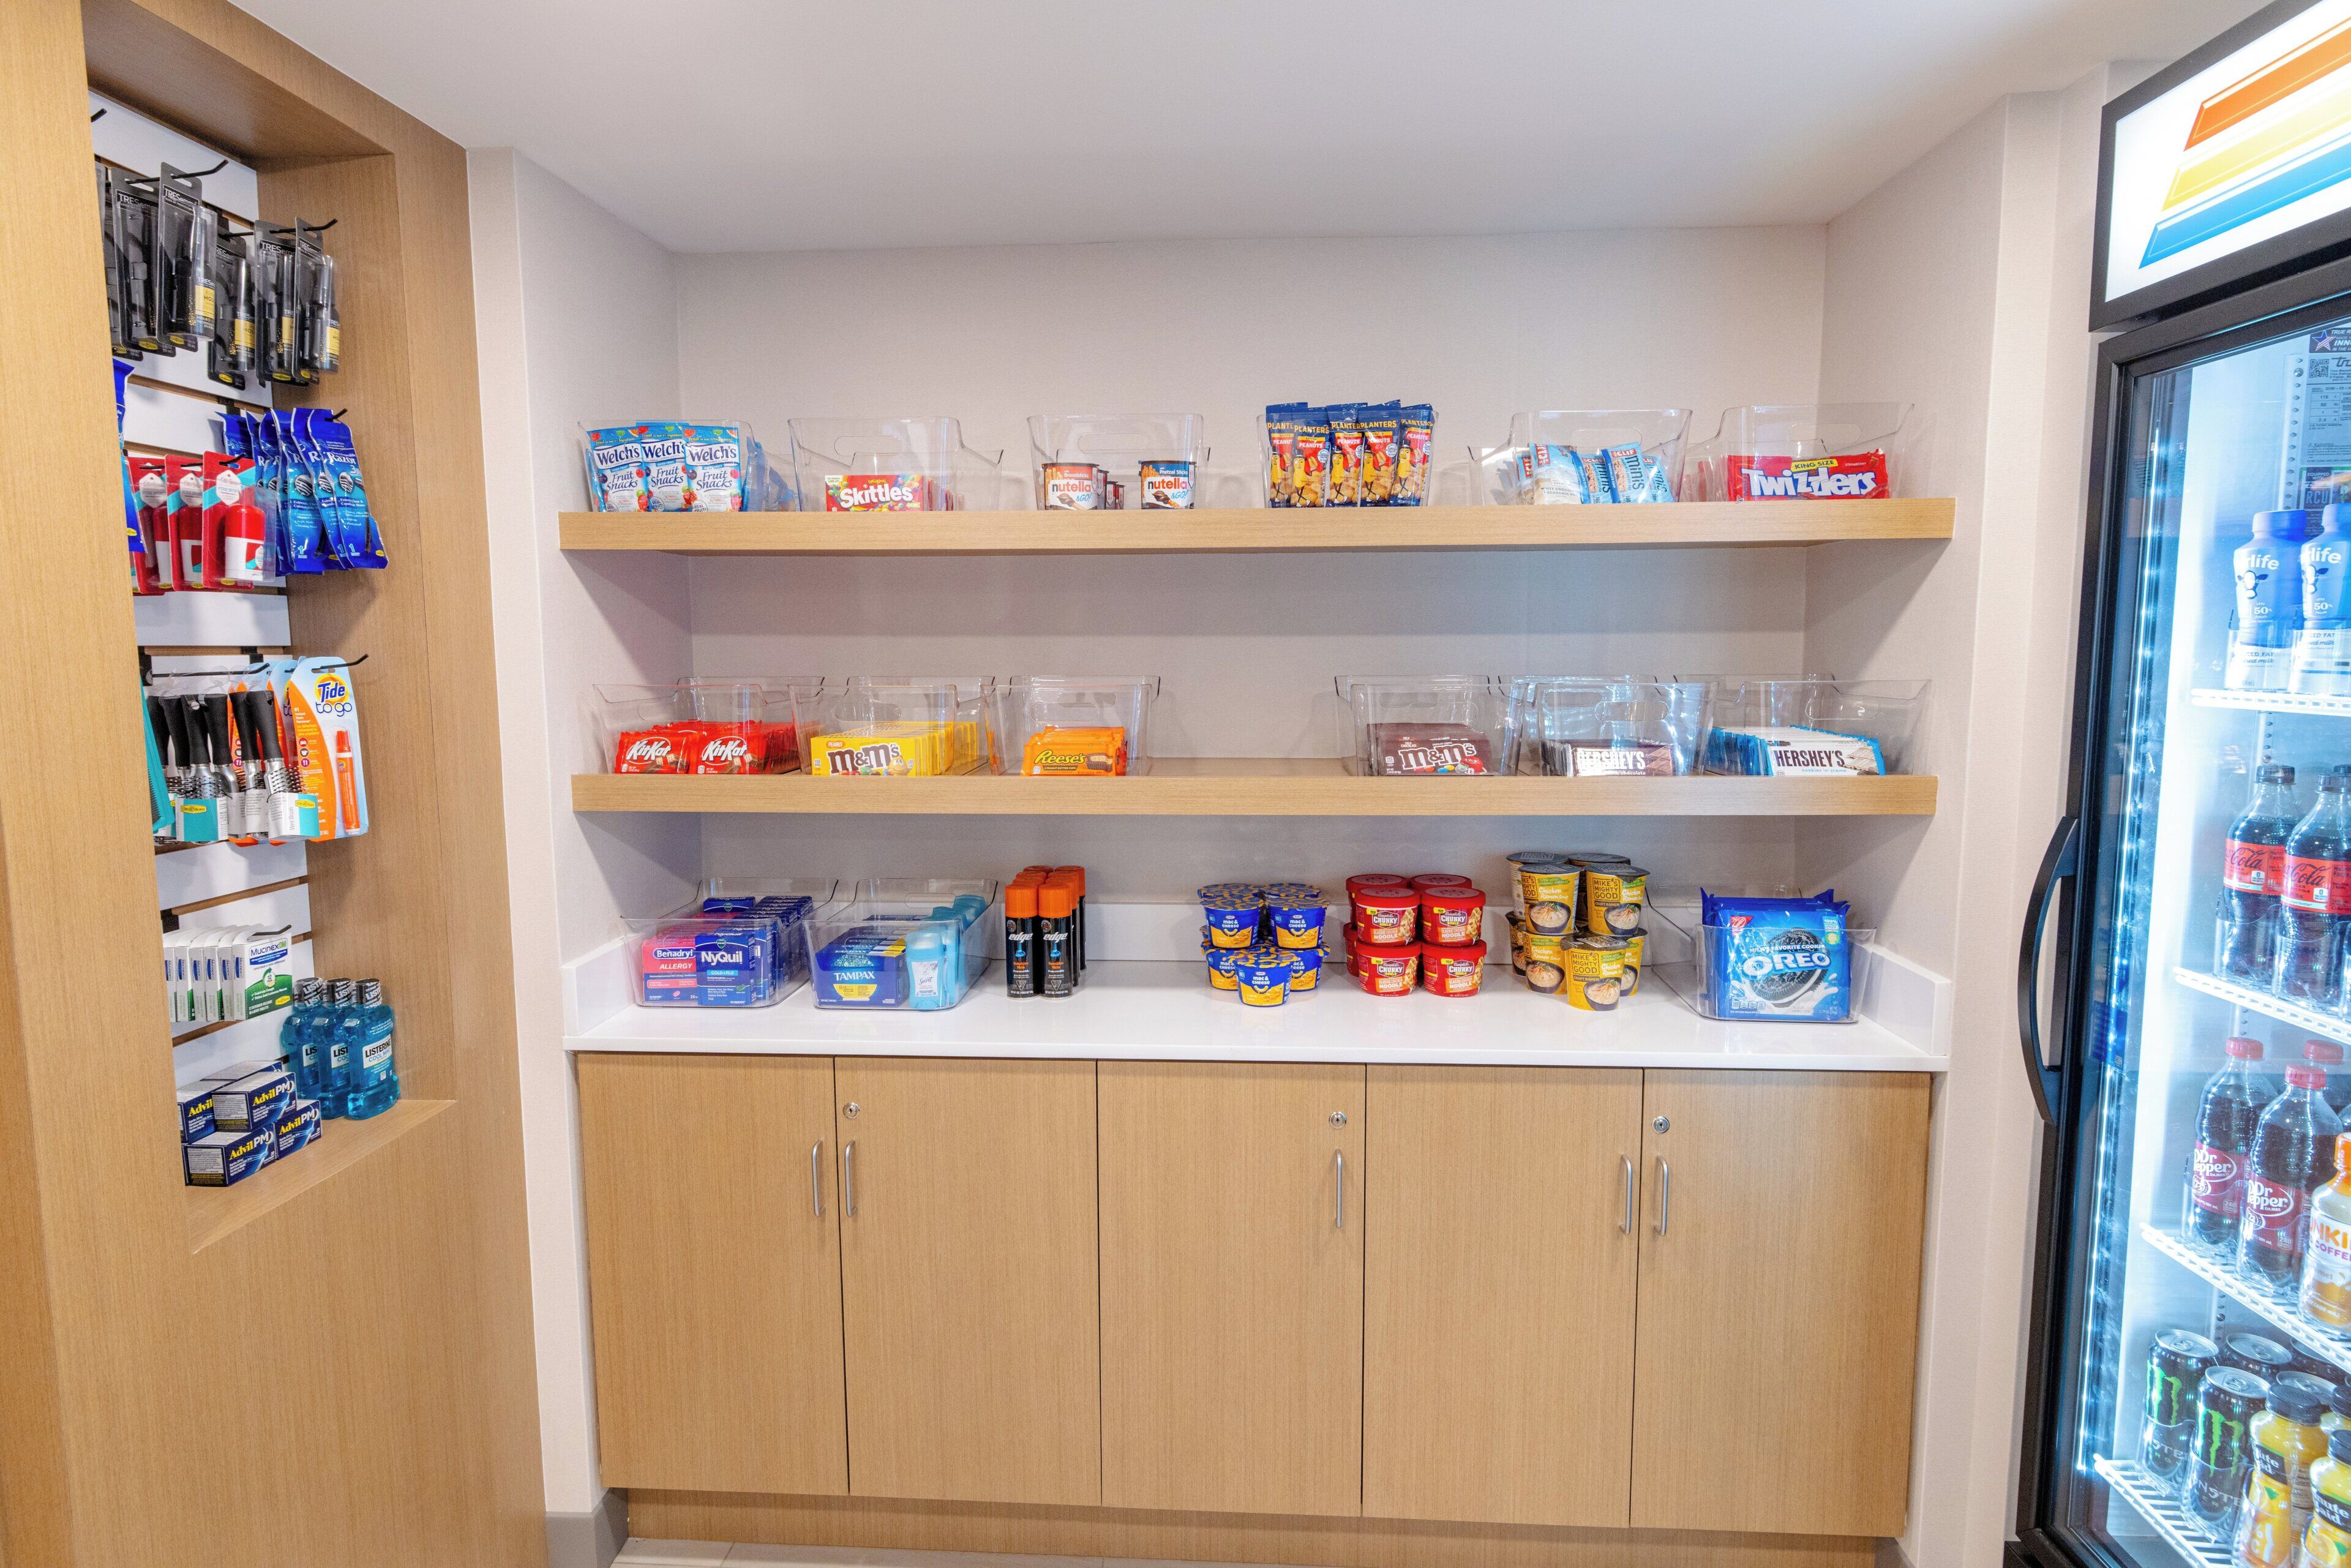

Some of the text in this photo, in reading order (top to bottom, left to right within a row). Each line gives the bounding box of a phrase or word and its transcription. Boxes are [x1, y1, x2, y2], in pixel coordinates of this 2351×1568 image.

[327, 452, 356, 464] Razor
[596, 446, 639, 465] Welch's
[689, 446, 736, 462] Welch's
[612, 471, 634, 482] Fruit
[657, 466, 679, 478] Fruit
[703, 471, 727, 482] Fruit
[1625, 456, 1644, 490] minis
[607, 479, 638, 491] Snacks
[651, 475, 683, 487] Snacks
[696, 479, 732, 490] Snacks
[1052, 480, 1091, 492] nutella
[1148, 478, 1187, 489] nutella
[1741, 467, 1877, 496] Twizzlers
[839, 484, 913, 508] Skittles
[1076, 492, 1092, 502] &GO!
[1171, 489, 1188, 499] &GO!
[318, 682, 345, 703] Tide
[315, 702, 352, 717] to go
[626, 741, 671, 760] KitKat
[702, 741, 748, 760] KitKat
[1034, 749, 1086, 763] Reese's
[1398, 743, 1477, 770] m&m's
[828, 743, 899, 774] m&m's
[1776, 750, 1845, 767] HERSHEY'S
[1008, 932, 1033, 943] edge
[1043, 932, 1068, 943] edge
[251, 943, 279, 956] Mucinex
[657, 950, 692, 959] Benadryl
[702, 951, 743, 965] NyQuil
[1743, 953, 1830, 976] OREO
[834, 971, 875, 981] TAMPAX
[252, 1081, 290, 1106] Advil PM
[279, 1109, 315, 1135] Advil PM
[230, 1142, 253, 1160] Advil
[253, 1133, 268, 1147] PM
[2200, 1149, 2217, 1163] Dr
[2255, 1181, 2273, 1197] Dr
